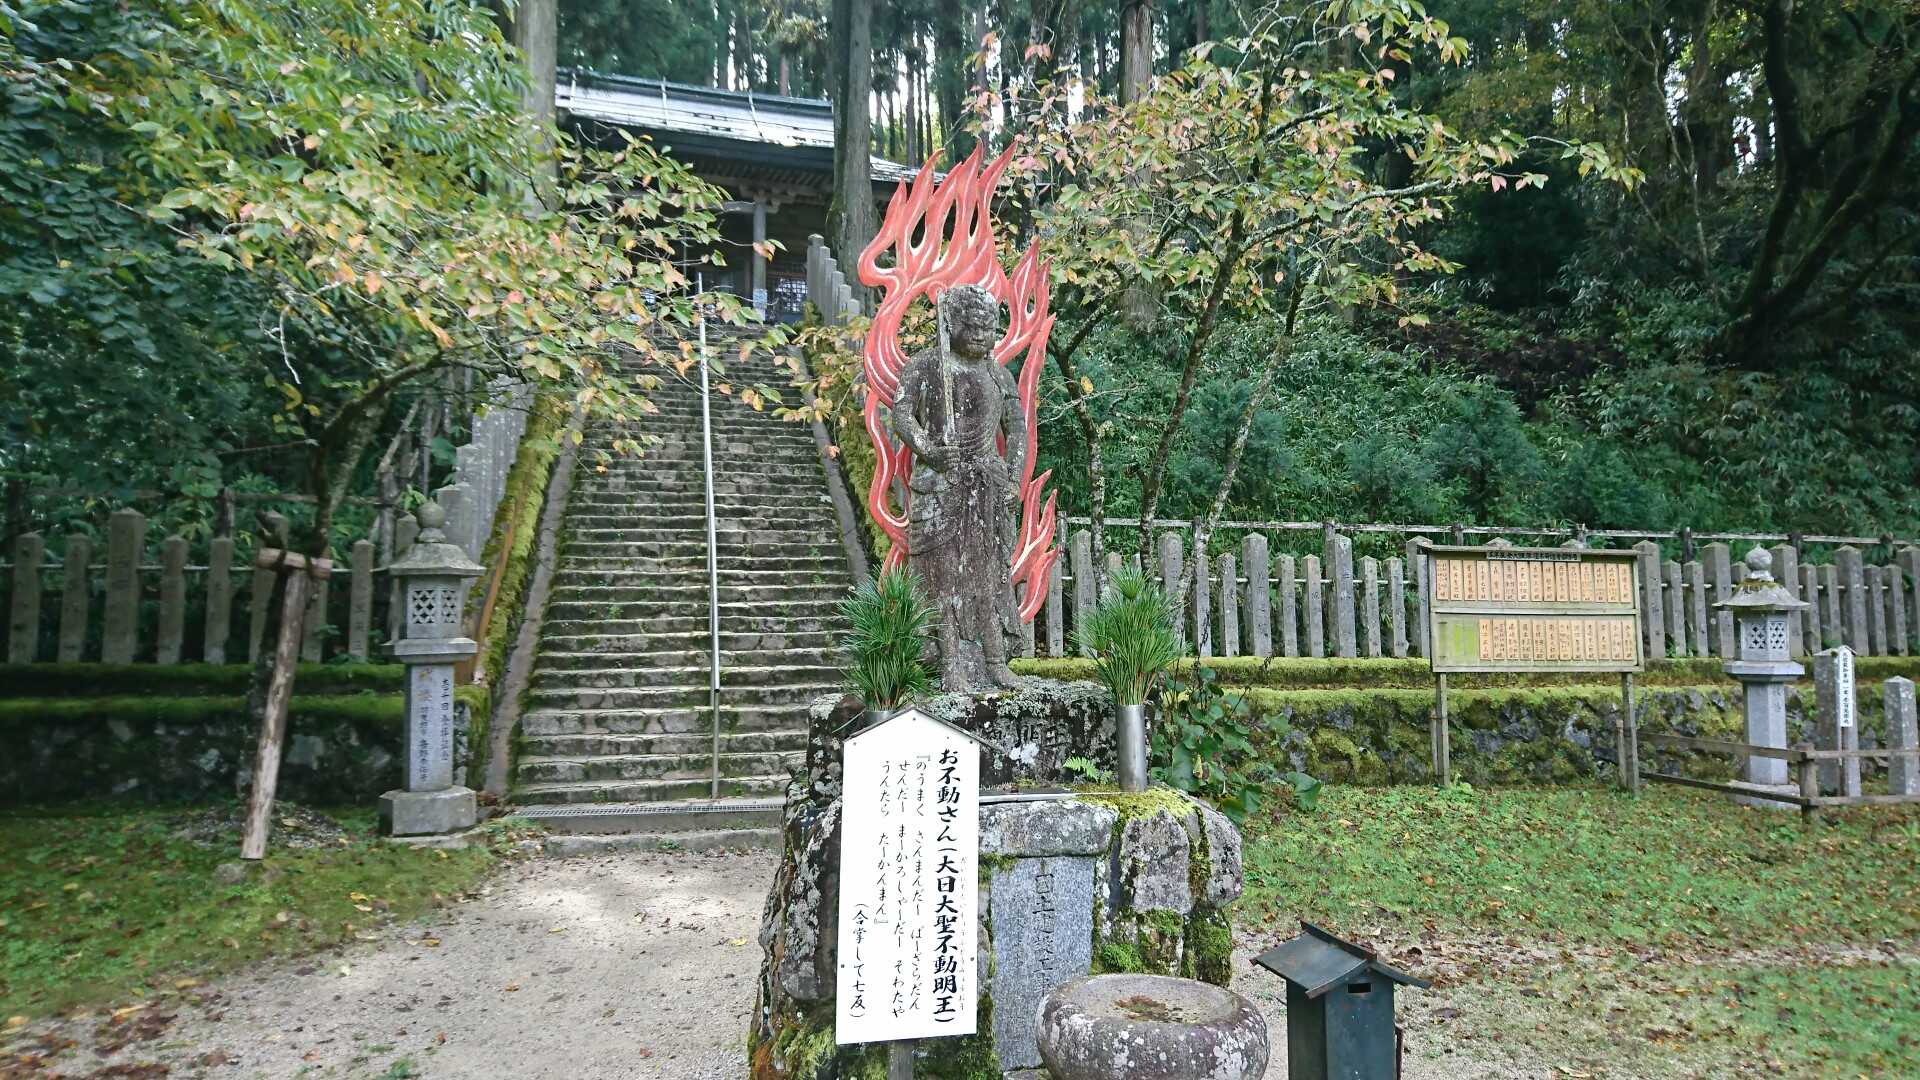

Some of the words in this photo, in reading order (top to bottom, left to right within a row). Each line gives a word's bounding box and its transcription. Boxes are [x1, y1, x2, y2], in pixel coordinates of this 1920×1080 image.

[879, 761, 890, 816] うんたら
[897, 760, 910, 813] せんだー
[912, 830, 925, 916] さんまんだー
[933, 748, 961, 1023] お不動さん（大日大聖不動明王）
[849, 903, 869, 1018] （合掌して七反）
